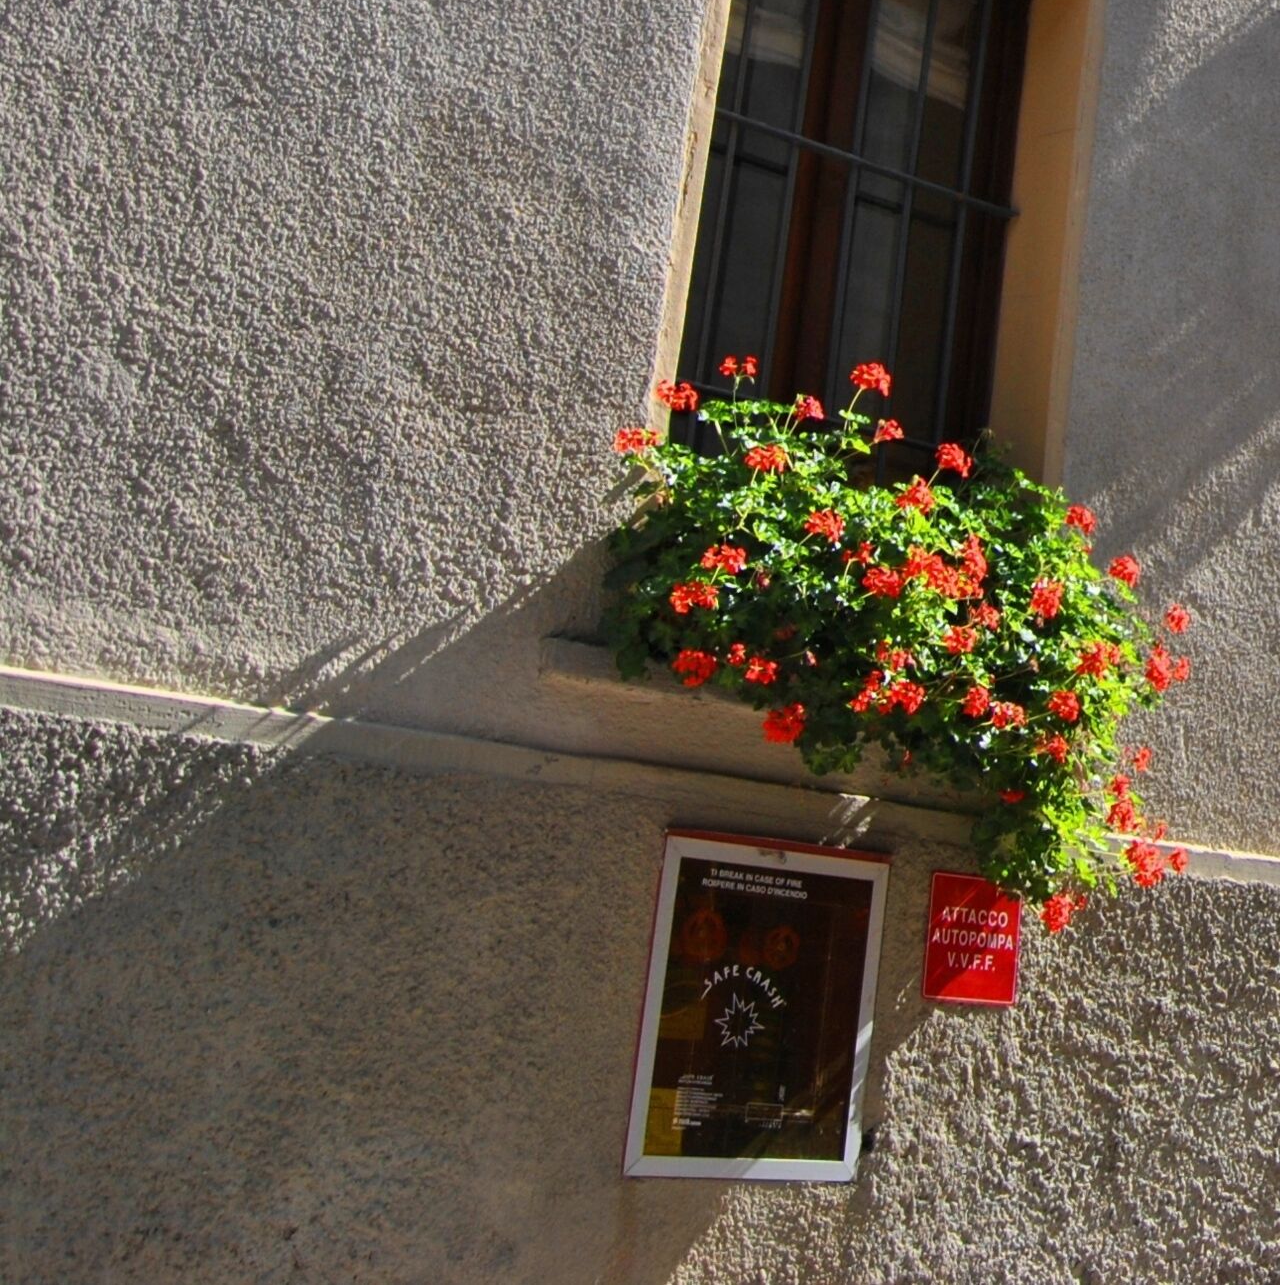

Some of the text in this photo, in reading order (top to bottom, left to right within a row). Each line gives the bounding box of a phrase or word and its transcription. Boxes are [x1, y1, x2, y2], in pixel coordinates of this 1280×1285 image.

[719, 869, 744, 881] BREAK
[745, 872, 753, 882] IN
[754, 874, 774, 885] CASE
[775, 877, 785, 886] OF
[736, 882, 745, 892] IN
[746, 883, 766, 895] CASO
[942, 906, 1009, 928] ATTACCO
[932, 927, 1013, 951] AUTOPOMPA
[947, 951, 996, 972] V.V.F.F.
[701, 964, 784, 1009] SAFE CRASH
